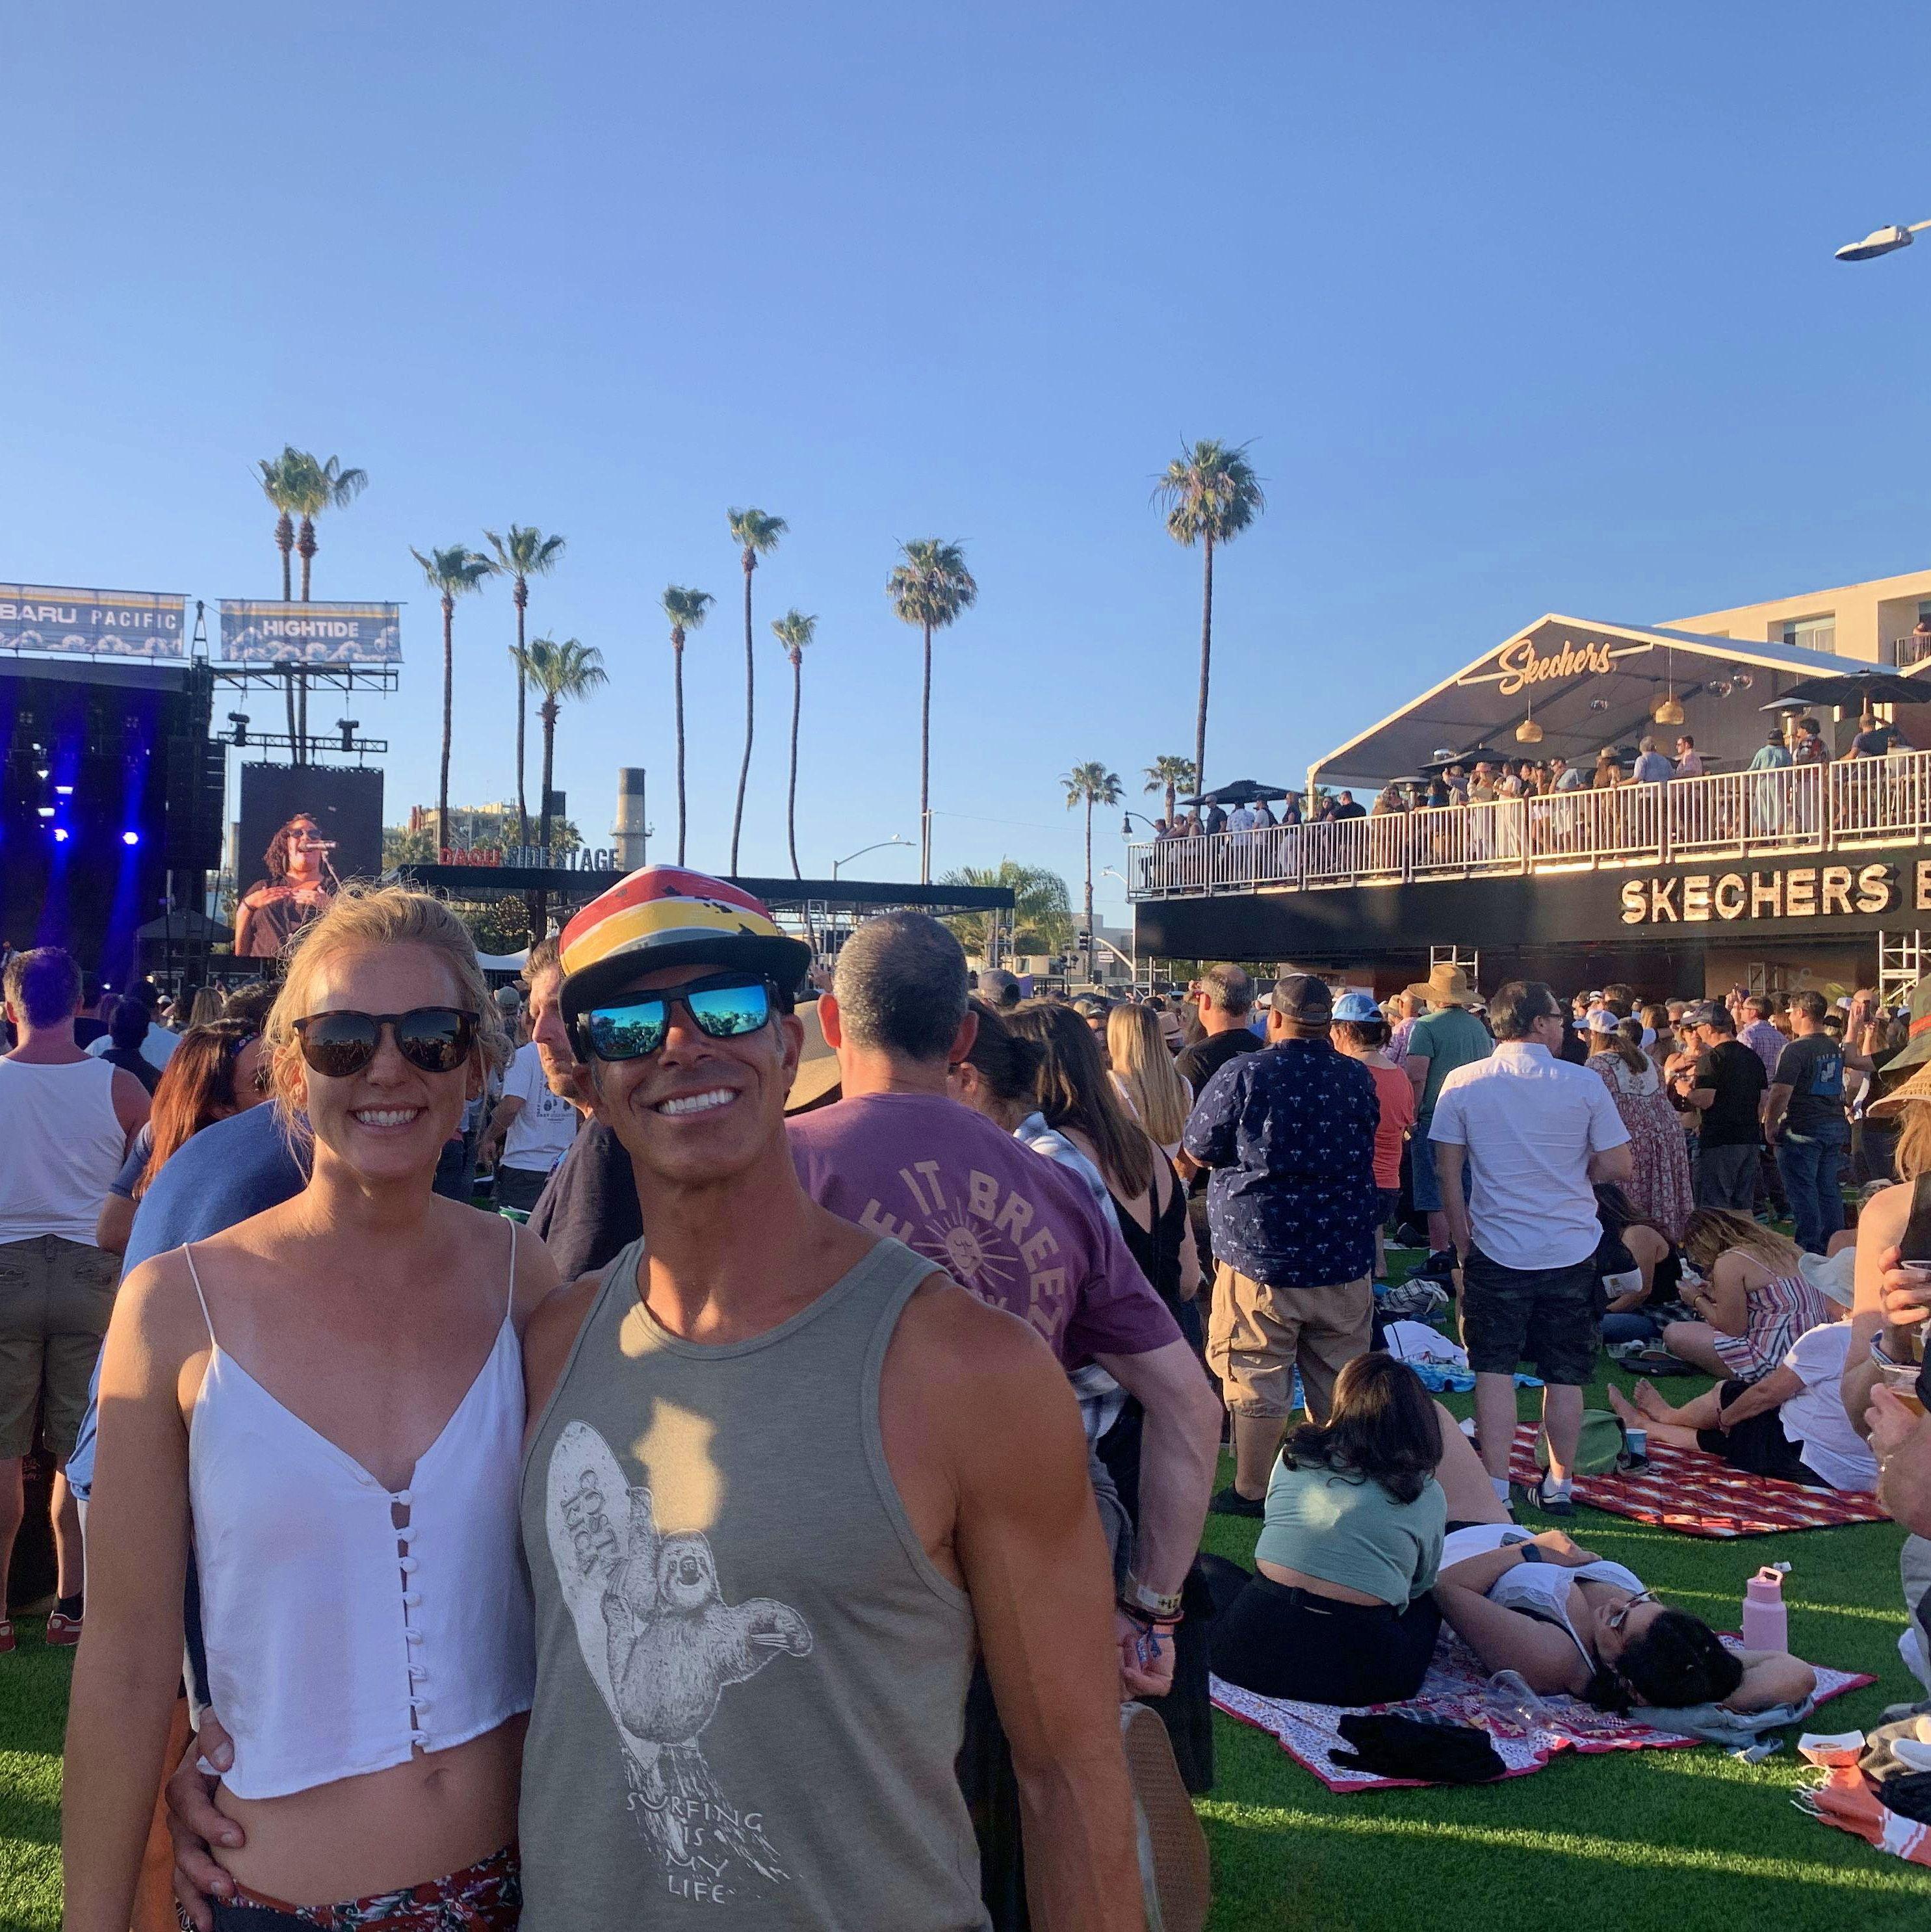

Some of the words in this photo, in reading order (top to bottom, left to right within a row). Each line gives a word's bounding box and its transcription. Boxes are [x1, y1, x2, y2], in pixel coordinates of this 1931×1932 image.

[91, 610, 176, 629] PACIFIC
[263, 620, 359, 637] HIGHTIDE
[1498, 638, 1610, 696] Skechers
[438, 846, 500, 867] DAOU
[1621, 863, 1889, 924] SKECHERS
[899, 1160, 946, 1216] IT
[560, 1494, 599, 1576] RICA
[578, 1469, 624, 1577] COSTA
[627, 1792, 762, 1832] SURFING
[684, 1827, 705, 1846] IS
[666, 1849, 729, 1877] MY
[669, 1875, 725, 1903] LIFE
